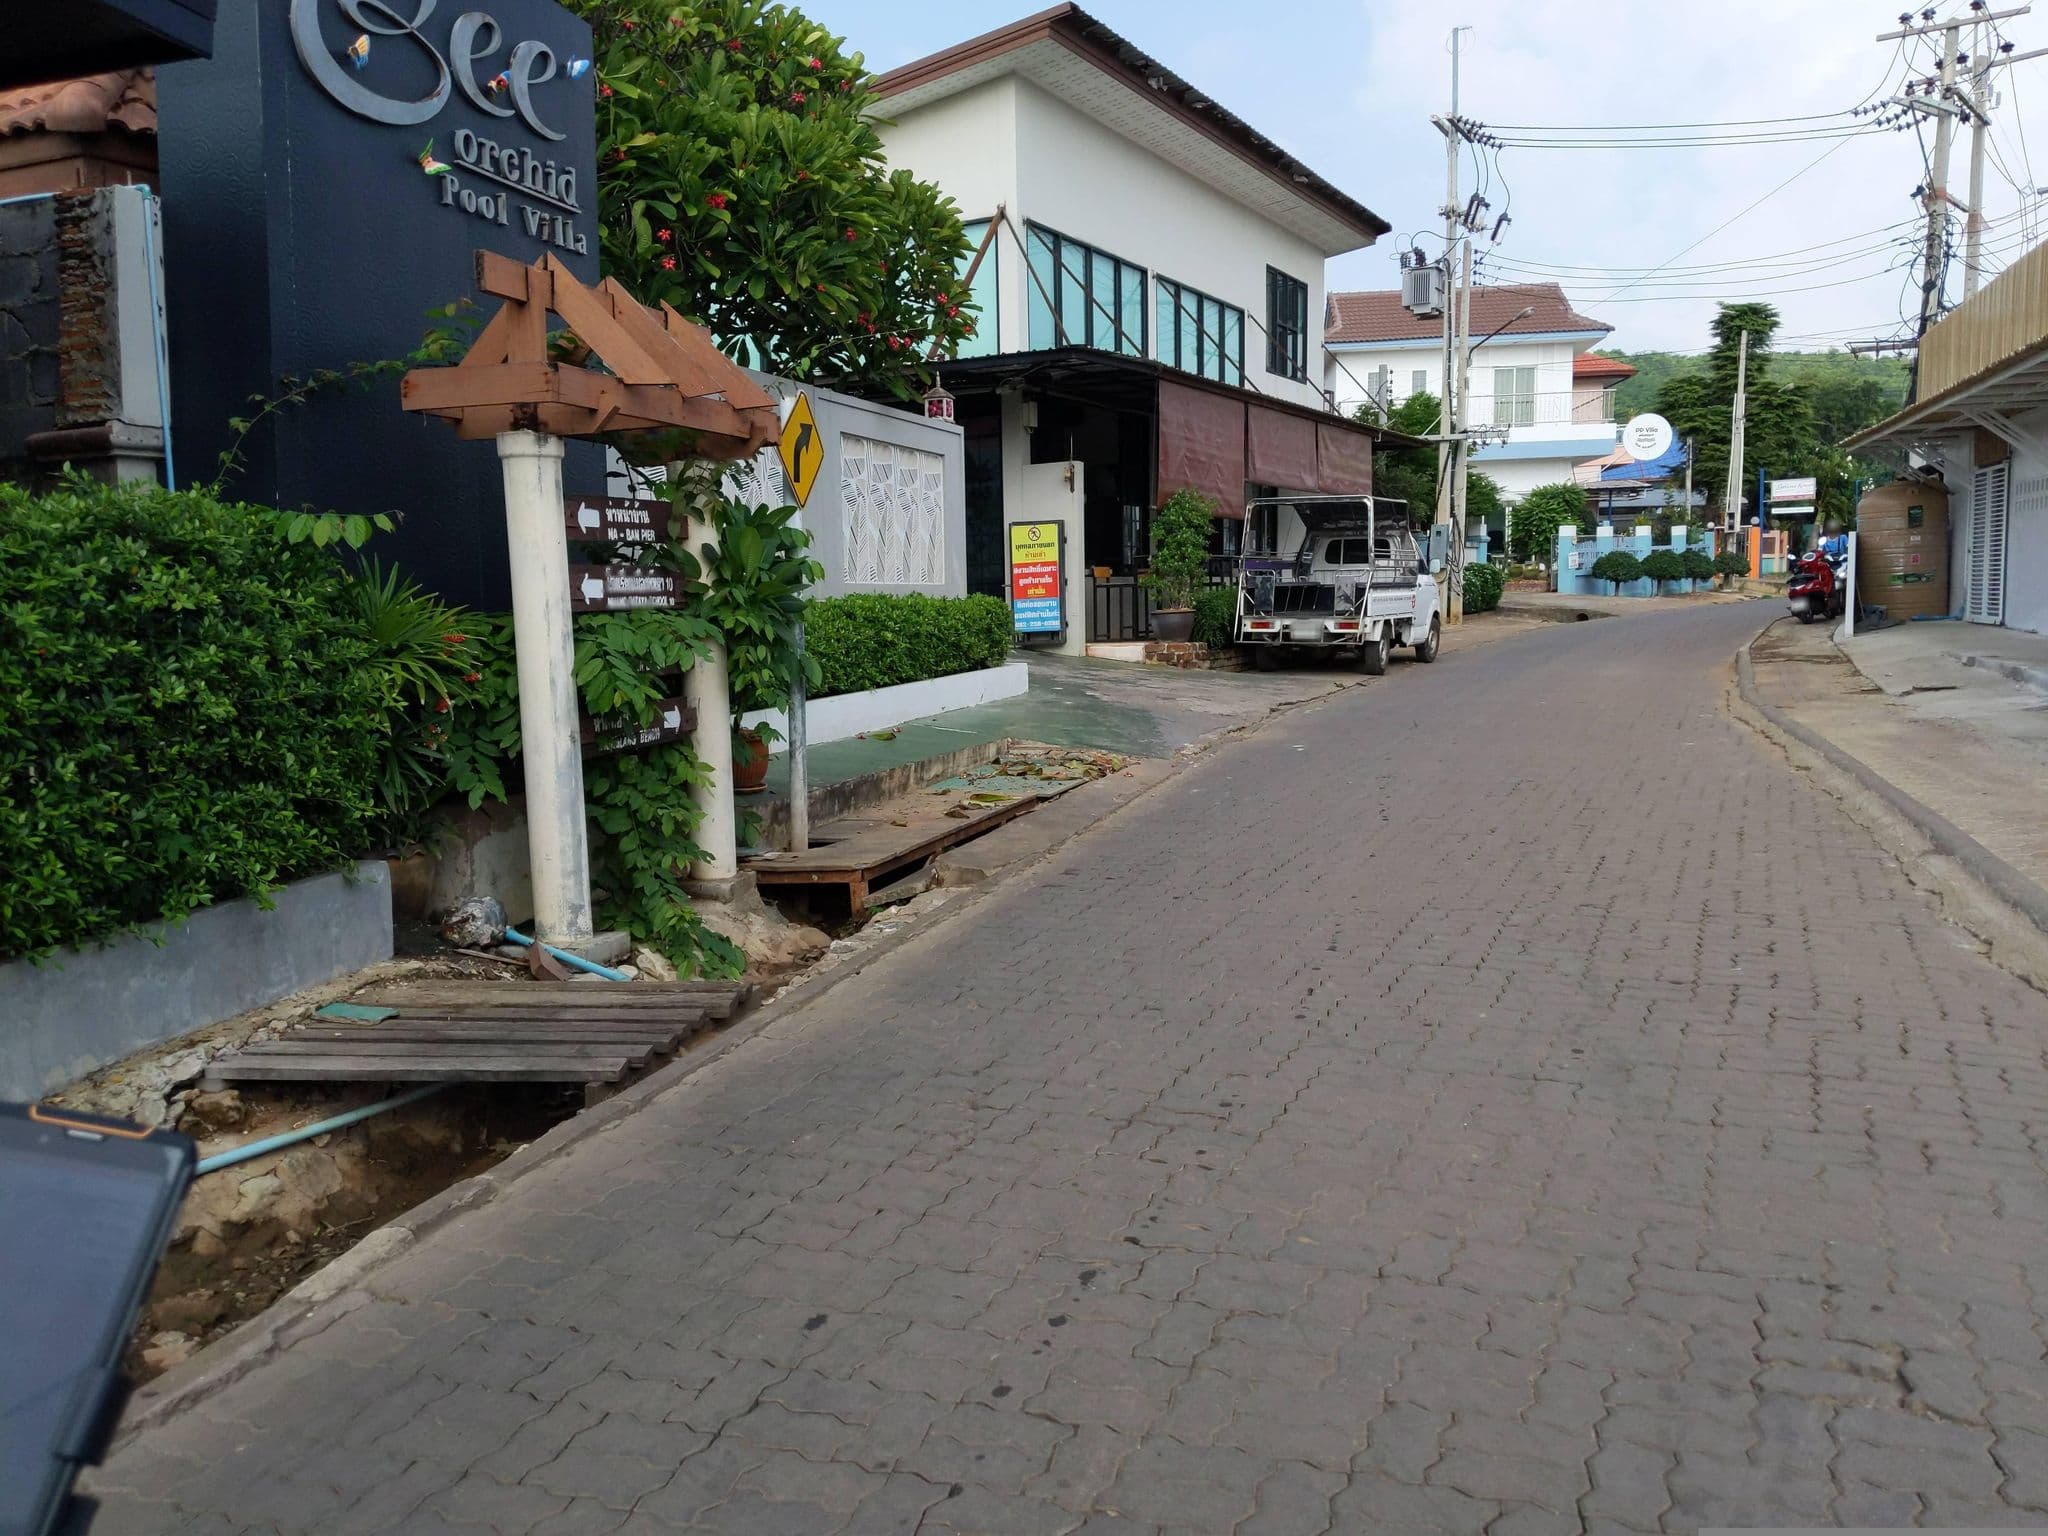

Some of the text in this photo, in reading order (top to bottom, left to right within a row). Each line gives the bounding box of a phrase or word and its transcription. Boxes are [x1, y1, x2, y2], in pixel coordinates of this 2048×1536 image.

[440, 173, 588, 255] Pool Villa
[607, 527, 618, 541] NA
[625, 528, 640, 542] BAN
[641, 528, 656, 542] PIER
